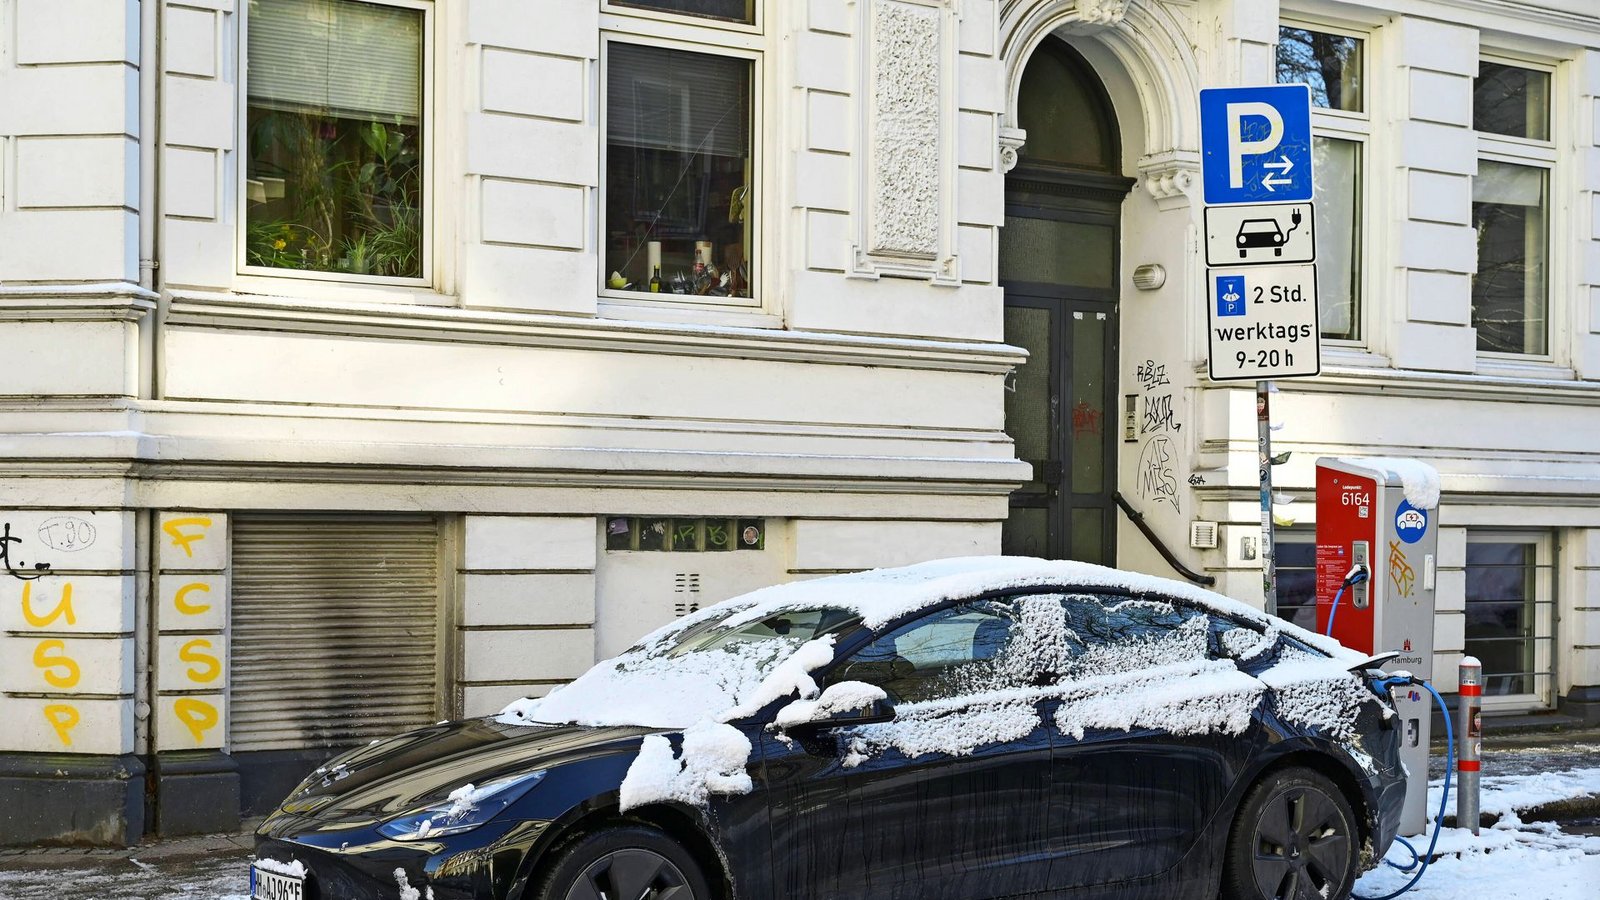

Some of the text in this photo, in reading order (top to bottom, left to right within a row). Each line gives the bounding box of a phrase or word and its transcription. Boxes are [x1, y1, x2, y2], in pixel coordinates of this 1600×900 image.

[1227, 102, 1284, 188] P
[1253, 284, 1307, 304] 2 Std.
[1228, 303, 1235, 313] P
[1217, 321, 1311, 343] werktags
[1236, 348, 1294, 369] 9-20 h
[1341, 492, 1370, 506] 6164
[1391, 656, 1422, 664] Hamburg
